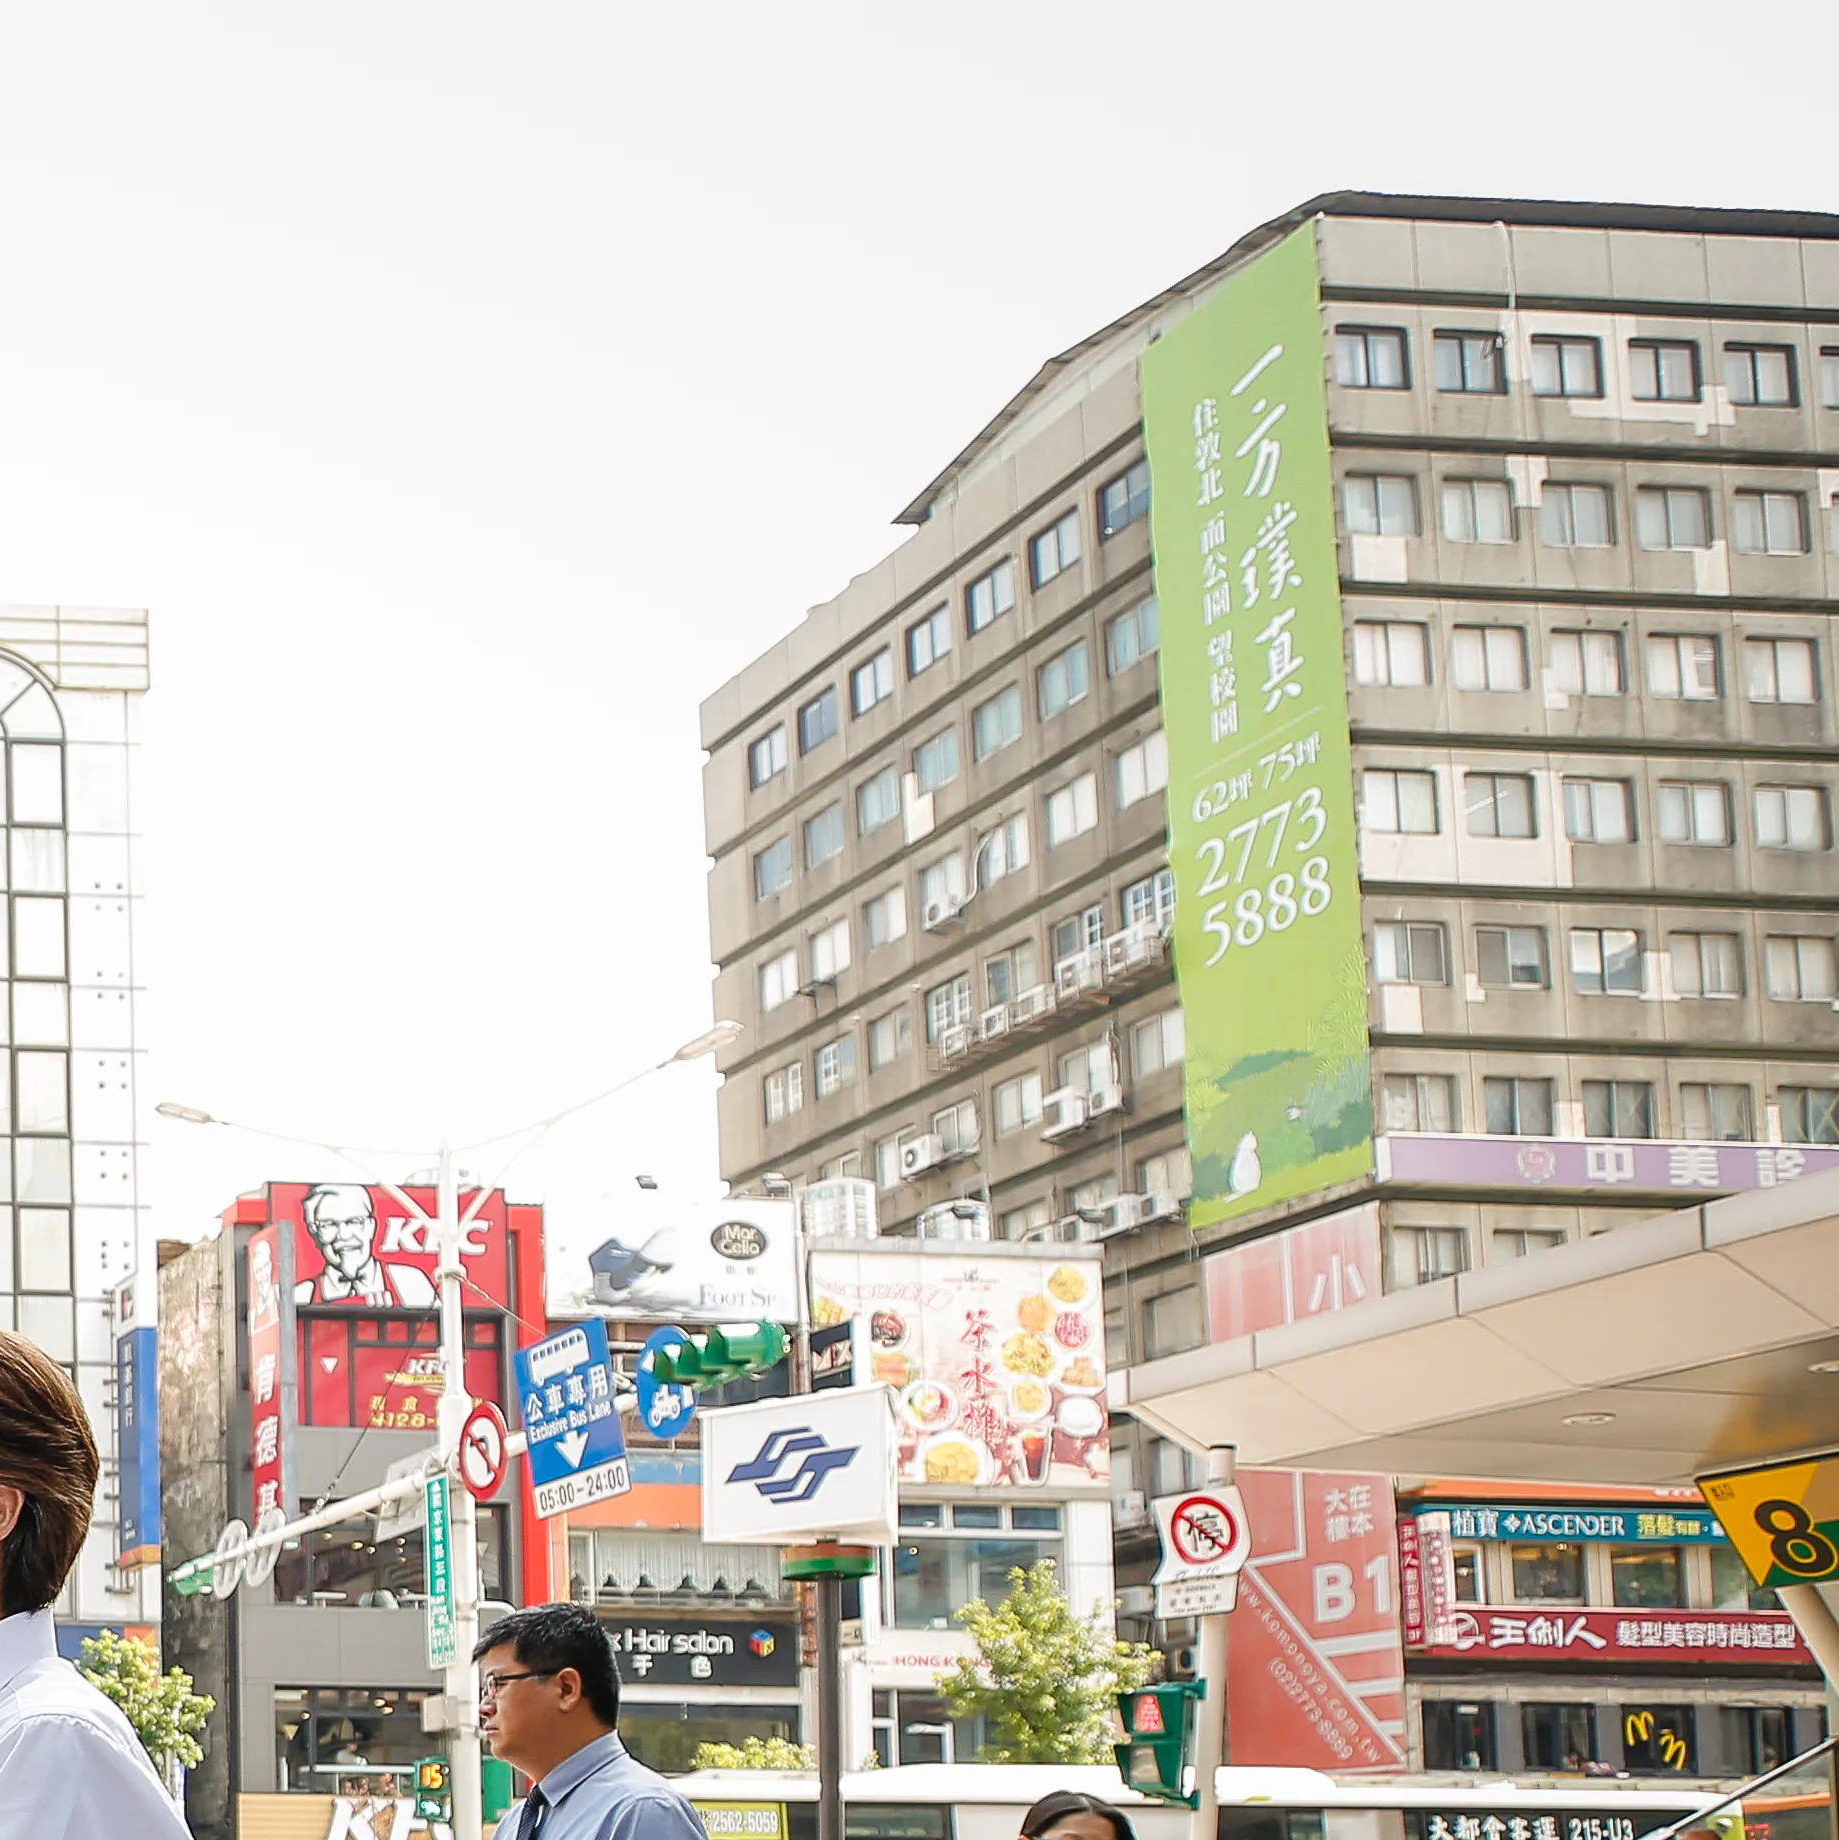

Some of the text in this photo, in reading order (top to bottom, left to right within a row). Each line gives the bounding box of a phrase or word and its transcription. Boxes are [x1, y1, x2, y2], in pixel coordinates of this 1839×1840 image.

[1230, 344, 1304, 713] 一方璞真
[1191, 731, 1321, 823] 62坪 75坪
[1195, 786, 1328, 898] 2773
[1202, 855, 1333, 968] 5888
[407, 1359, 446, 1375] KF
[527, 1364, 609, 1422] 公車專用
[371, 1412, 438, 1428] 4128-
[530, 1400, 613, 1444] Exclusive Bus Lane
[1187, 1511, 1223, 1553] 停
[1522, 1514, 1625, 1536] ASCENDER
[1313, 1554, 1392, 1624] B1
[623, 1628, 671, 1653] Hair
[672, 1629, 734, 1655] salon
[1616, 1619, 1797, 1650] 髮型美容時尚造型
[893, 1655, 942, 1668] HONG
[712, 1808, 779, 1835] 2562-5059
